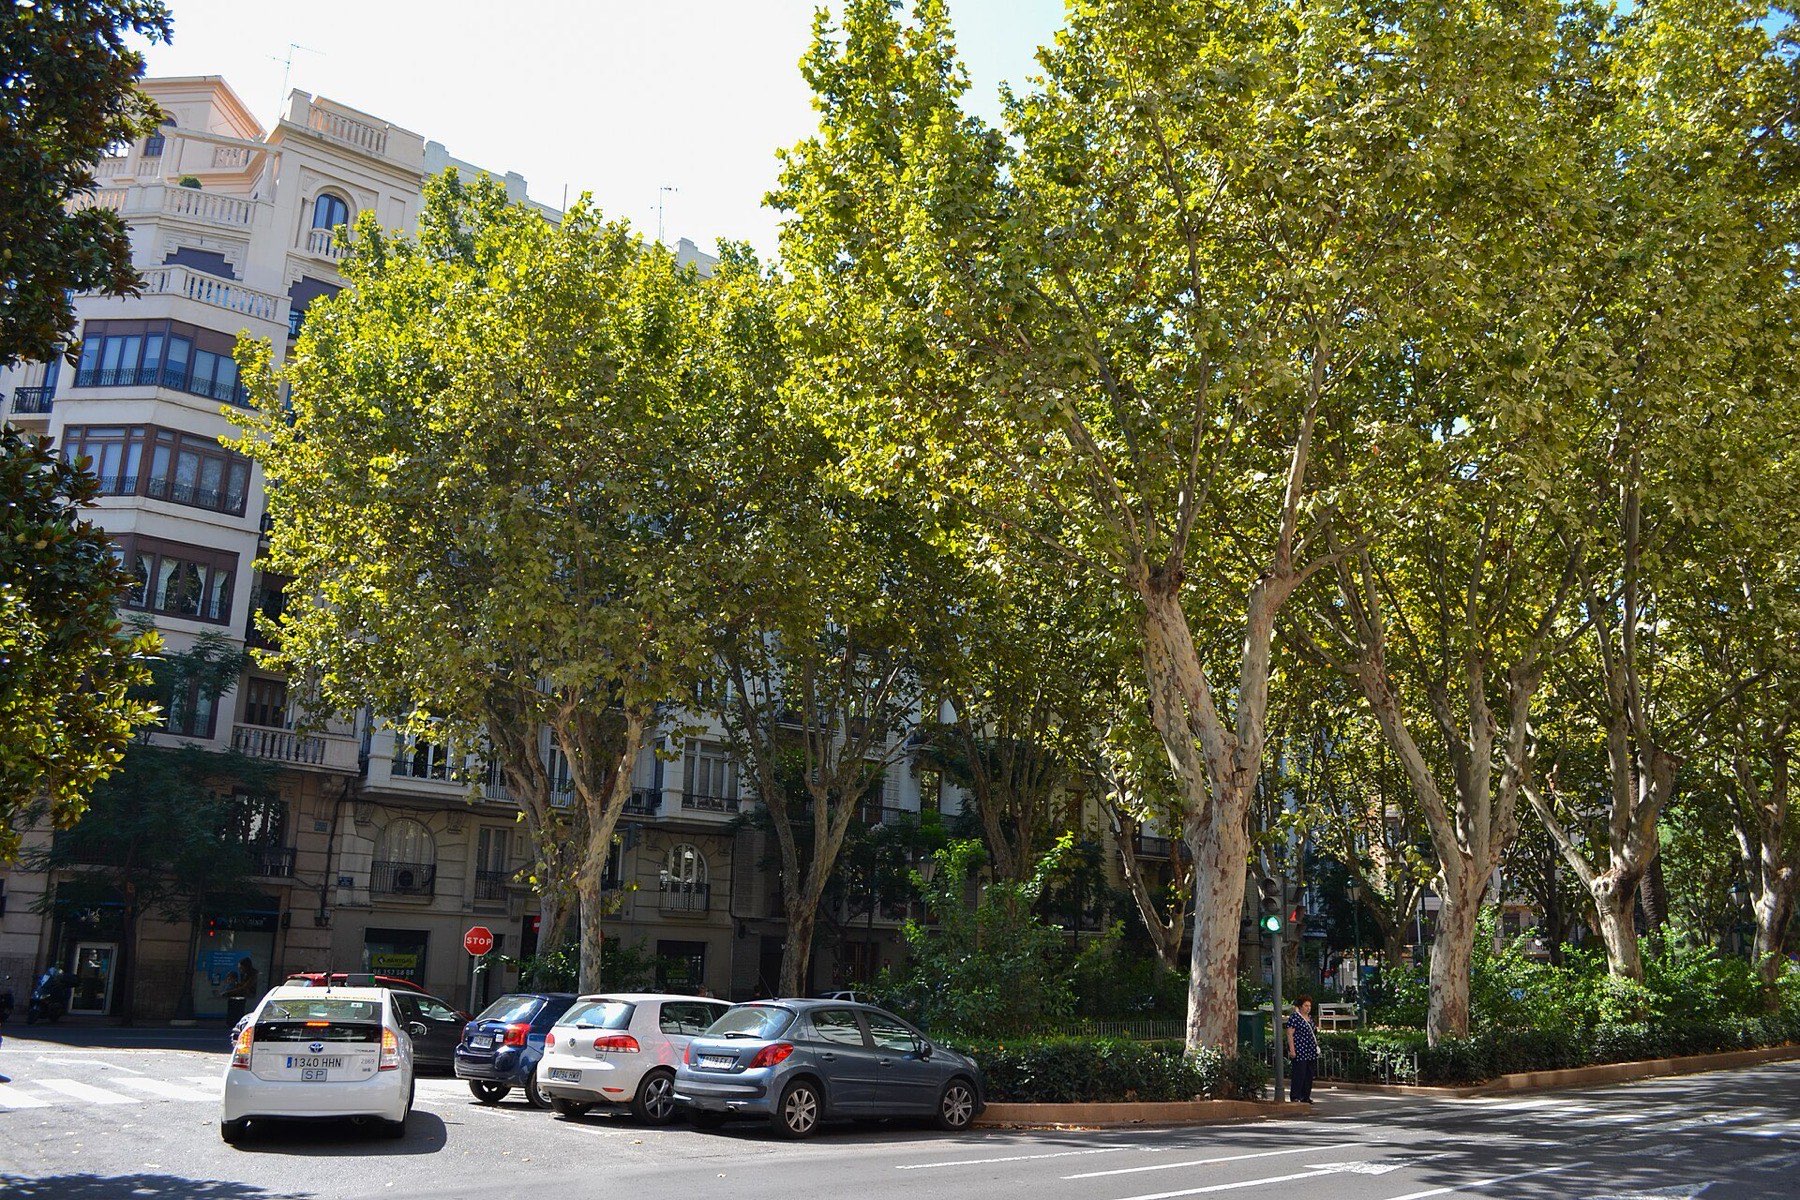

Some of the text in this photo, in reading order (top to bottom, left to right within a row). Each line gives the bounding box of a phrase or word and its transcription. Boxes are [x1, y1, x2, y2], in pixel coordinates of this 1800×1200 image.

[466, 937, 492, 946] STOP
[294, 1057, 342, 1068] 1340 HHN
[305, 1070, 324, 1080] SP
